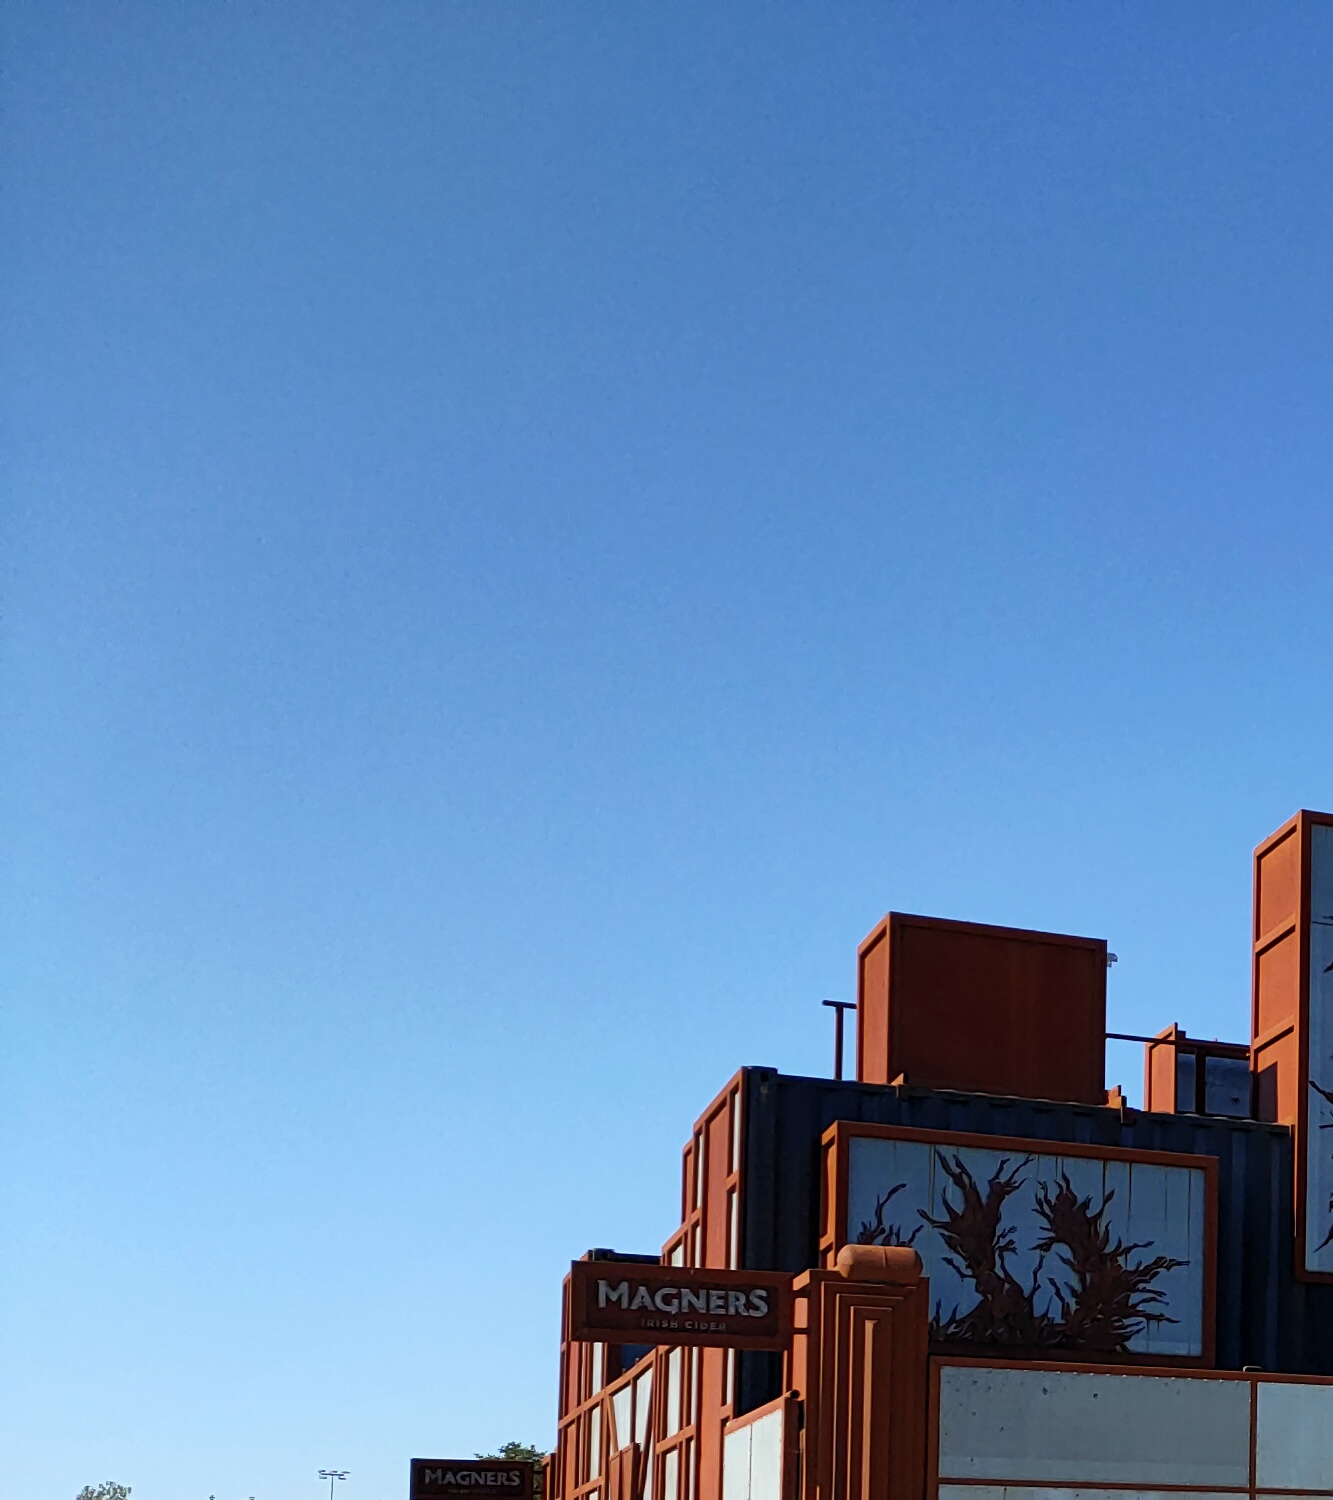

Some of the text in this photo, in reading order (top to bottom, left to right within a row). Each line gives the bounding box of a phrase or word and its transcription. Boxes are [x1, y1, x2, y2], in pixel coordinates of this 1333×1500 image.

[597, 1279, 769, 1317] MAGNERS
[641, 1319, 678, 1329] IRISH
[424, 1468, 520, 1486] MAGNERS
